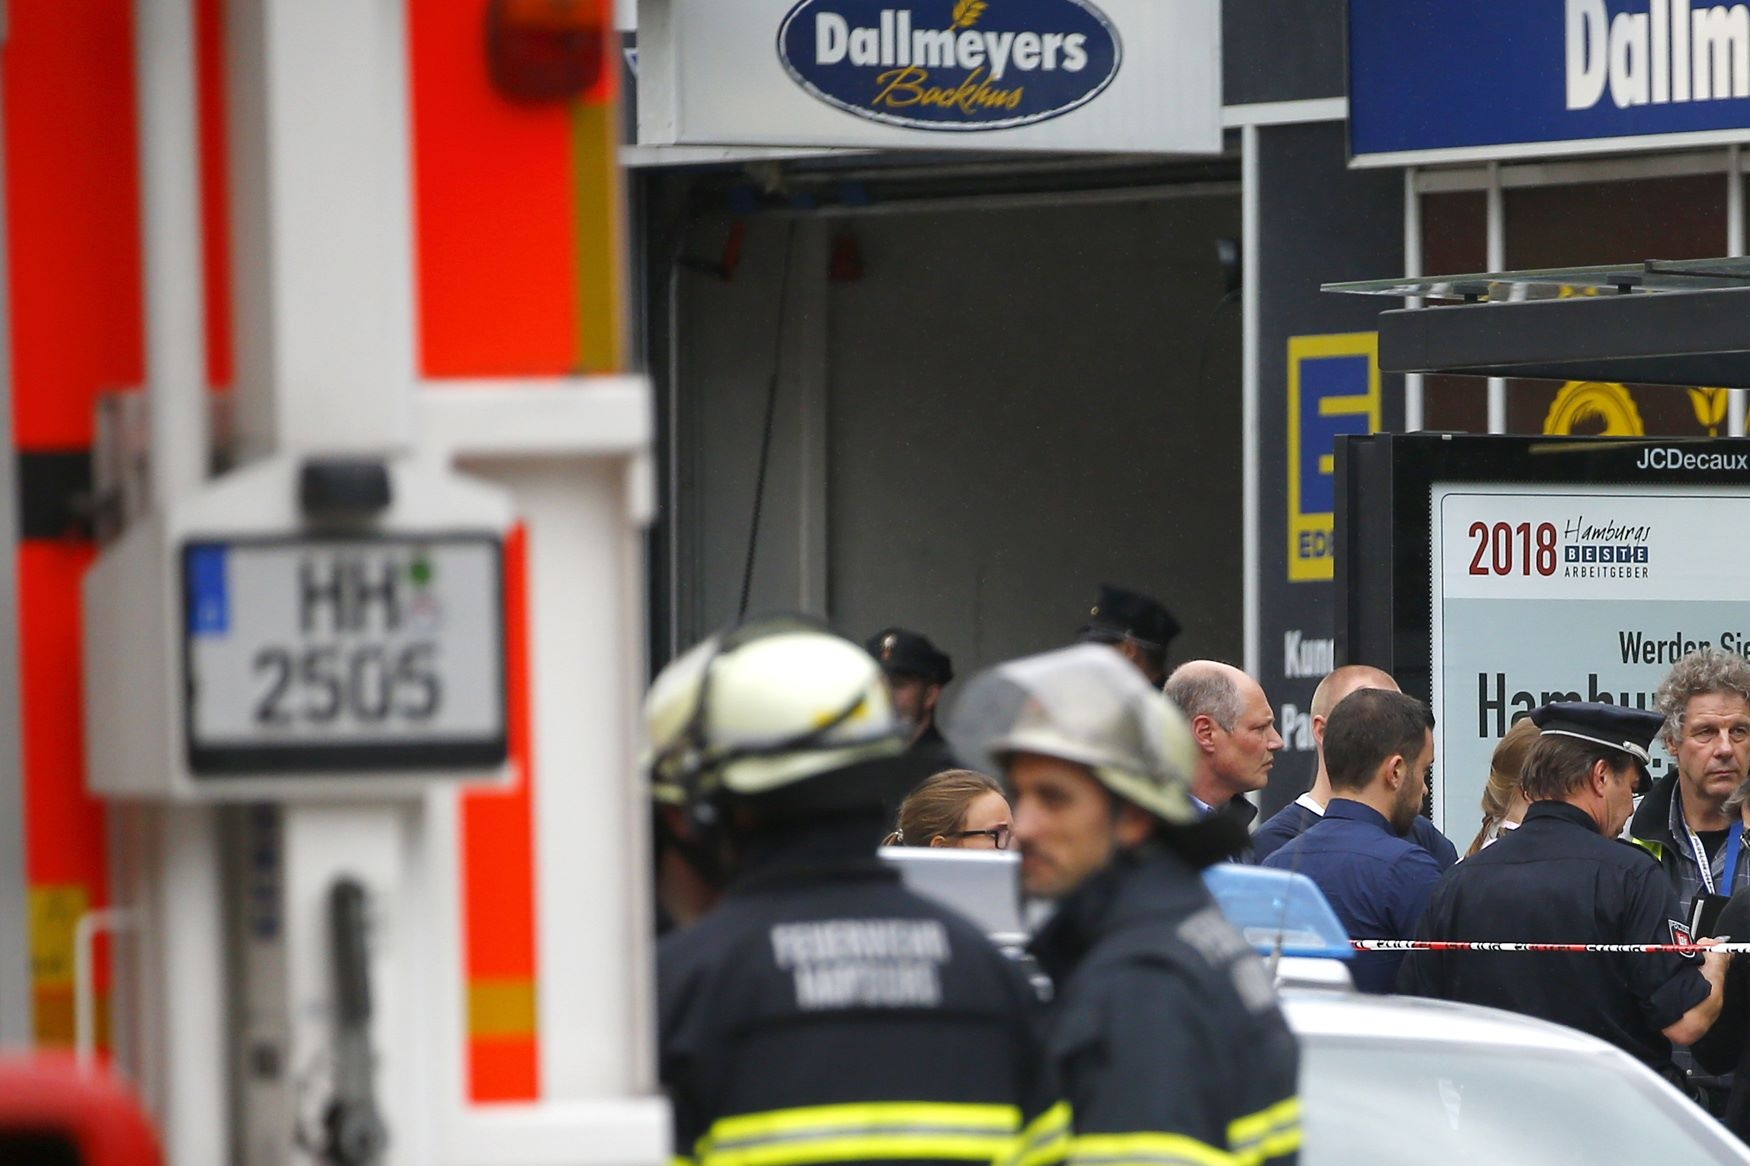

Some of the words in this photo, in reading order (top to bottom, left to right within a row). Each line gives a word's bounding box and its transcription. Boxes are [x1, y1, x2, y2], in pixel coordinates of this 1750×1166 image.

[815, 9, 1088, 81] Dallmeyers
[872, 66, 1024, 115] Backhus
[1636, 447, 1749, 470] JCDecaux
[1468, 521, 1558, 577] 2018
[1564, 515, 1651, 553] Hamburgs
[1566, 547, 1647, 562] BESTE
[1564, 566, 1649, 579] ARBEITGEBER
[298, 560, 402, 635] HH
[254, 643, 443, 724] 2505
